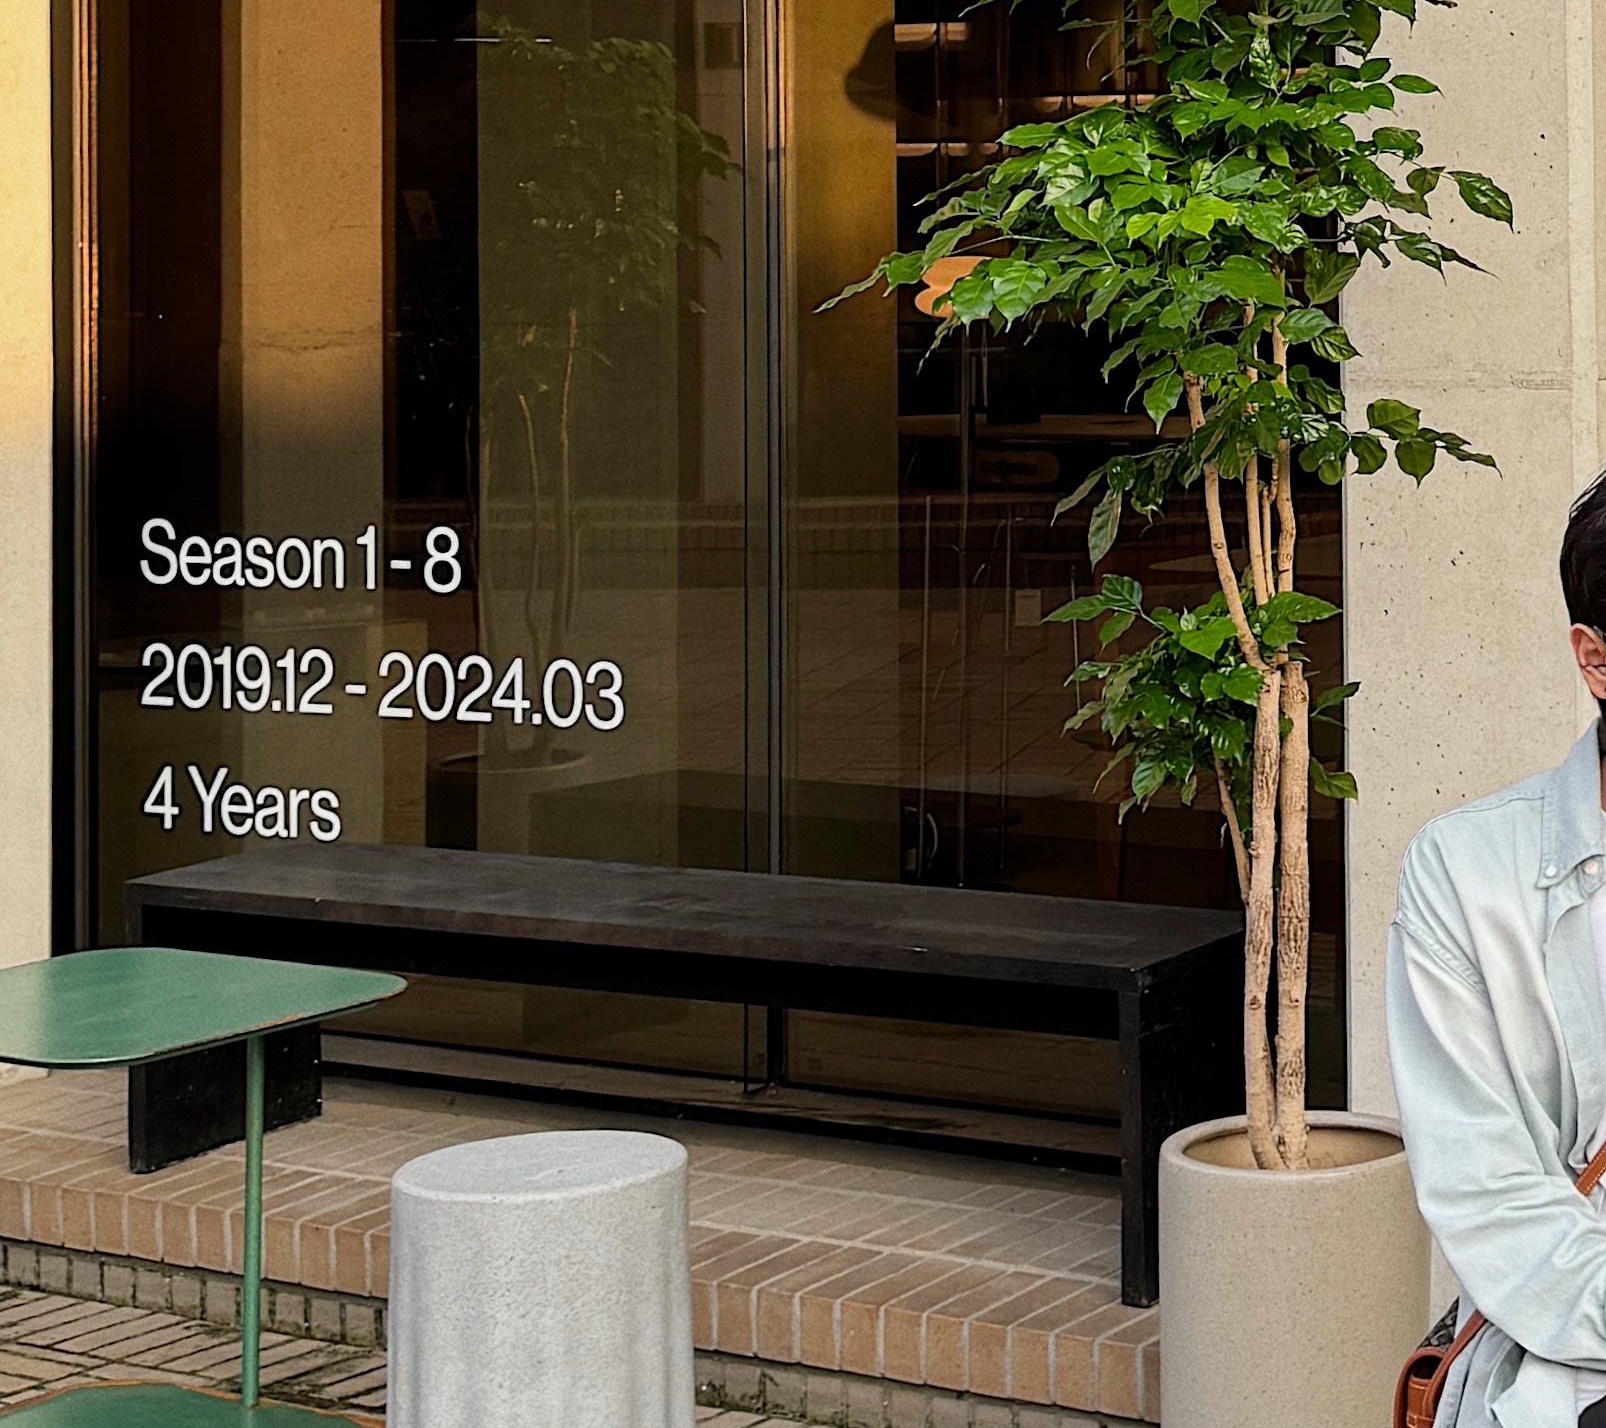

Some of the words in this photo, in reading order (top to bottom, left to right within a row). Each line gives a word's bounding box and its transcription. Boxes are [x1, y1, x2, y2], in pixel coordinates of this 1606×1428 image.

[140, 518, 345, 590] Season
[423, 526, 463, 593] 8
[141, 642, 335, 714] 2019.12
[378, 651, 625, 730] 2024.03
[143, 765, 180, 830] 4
[187, 765, 342, 842] Years
